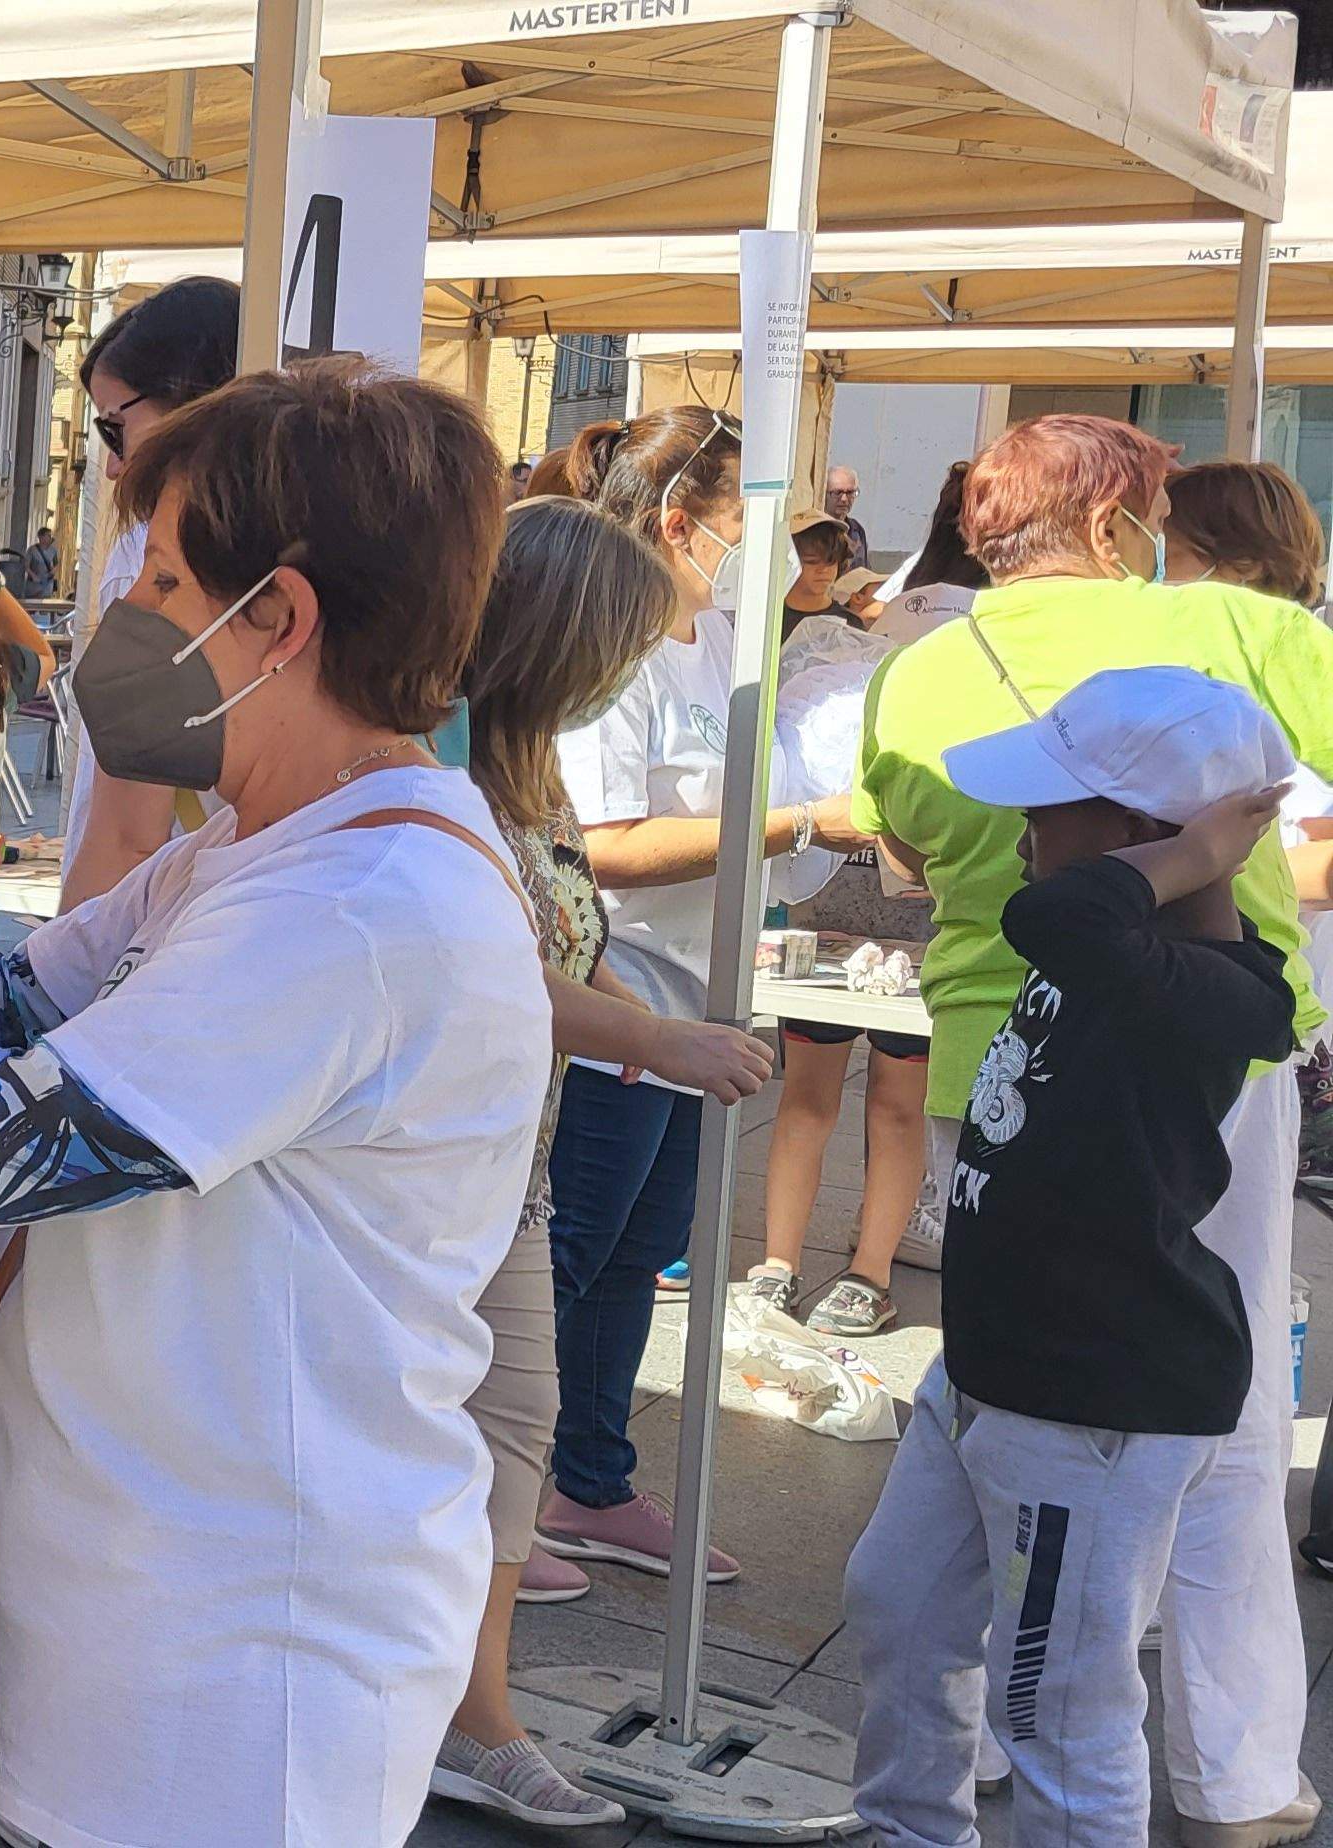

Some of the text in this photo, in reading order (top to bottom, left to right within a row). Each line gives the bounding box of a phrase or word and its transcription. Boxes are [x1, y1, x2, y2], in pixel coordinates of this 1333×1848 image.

[509, 0, 691, 33] MASTERTENT
[1187, 246, 1302, 261] MASTEENT
[281, 193, 365, 358] 4
